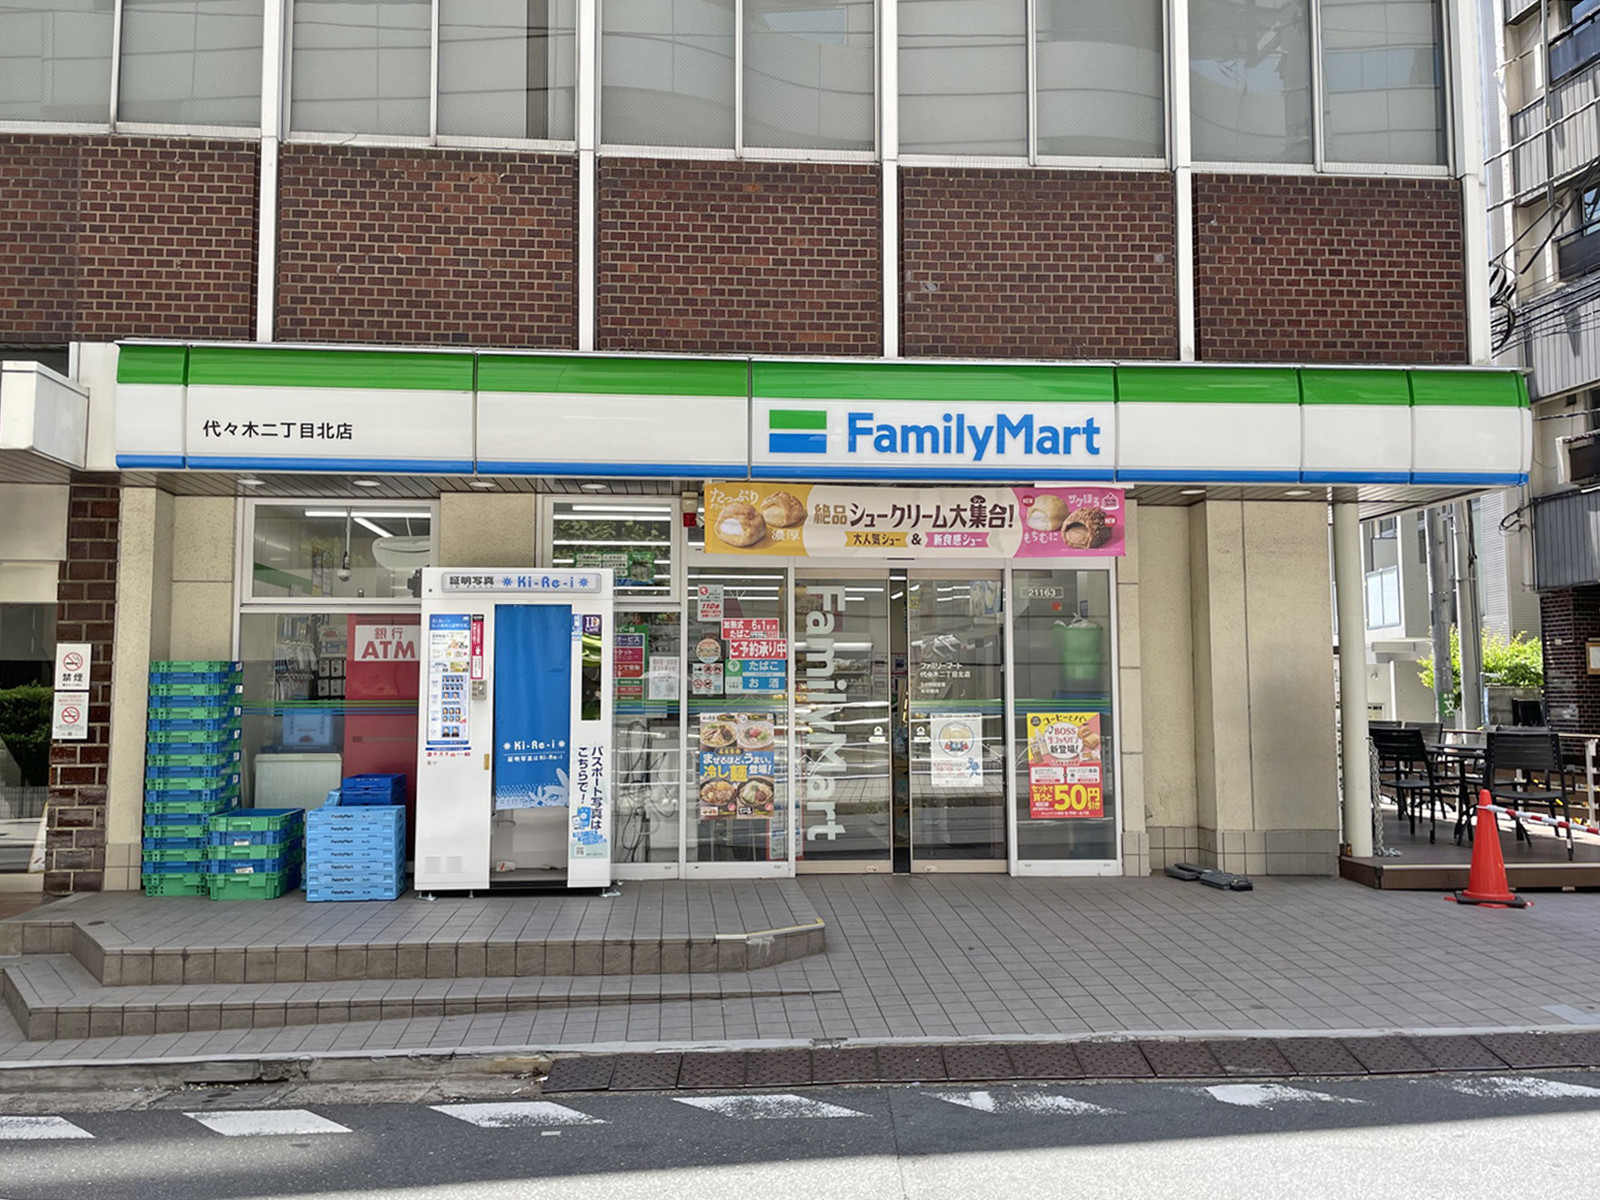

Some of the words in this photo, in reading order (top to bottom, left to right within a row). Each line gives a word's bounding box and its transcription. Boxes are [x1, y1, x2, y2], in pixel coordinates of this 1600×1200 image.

[203, 420, 353, 440] 代々木二丁目北店
[848, 412, 1100, 461] FamilyMart
[710, 488, 759, 505] たっぷり
[771, 529, 800, 541] 濃厚
[853, 534, 901, 546] 大人気シュー
[911, 534, 922, 545] &
[933, 534, 983, 546] 新食感シュー
[449, 576, 495, 585] 証明写真
[517, 576, 574, 588] Ki-Re-i
[1028, 589, 1056, 598] 21163
[375, 627, 403, 639] 銀行
[730, 630, 750, 638] たばこ
[361, 640, 416, 659] ATM
[731, 641, 786, 657] ご予約承り中
[749, 661, 778, 671] たばこ
[62, 673, 83, 682] 禁煙
[748, 678, 780, 688] お酒
[805, 586, 847, 840] FamilyMart
[1054, 727, 1077, 735] BOSS
[514, 739, 555, 751] Ki-Re-i
[704, 764, 748, 782] 冷し麺
[591, 746, 604, 829] パスポート写真は
